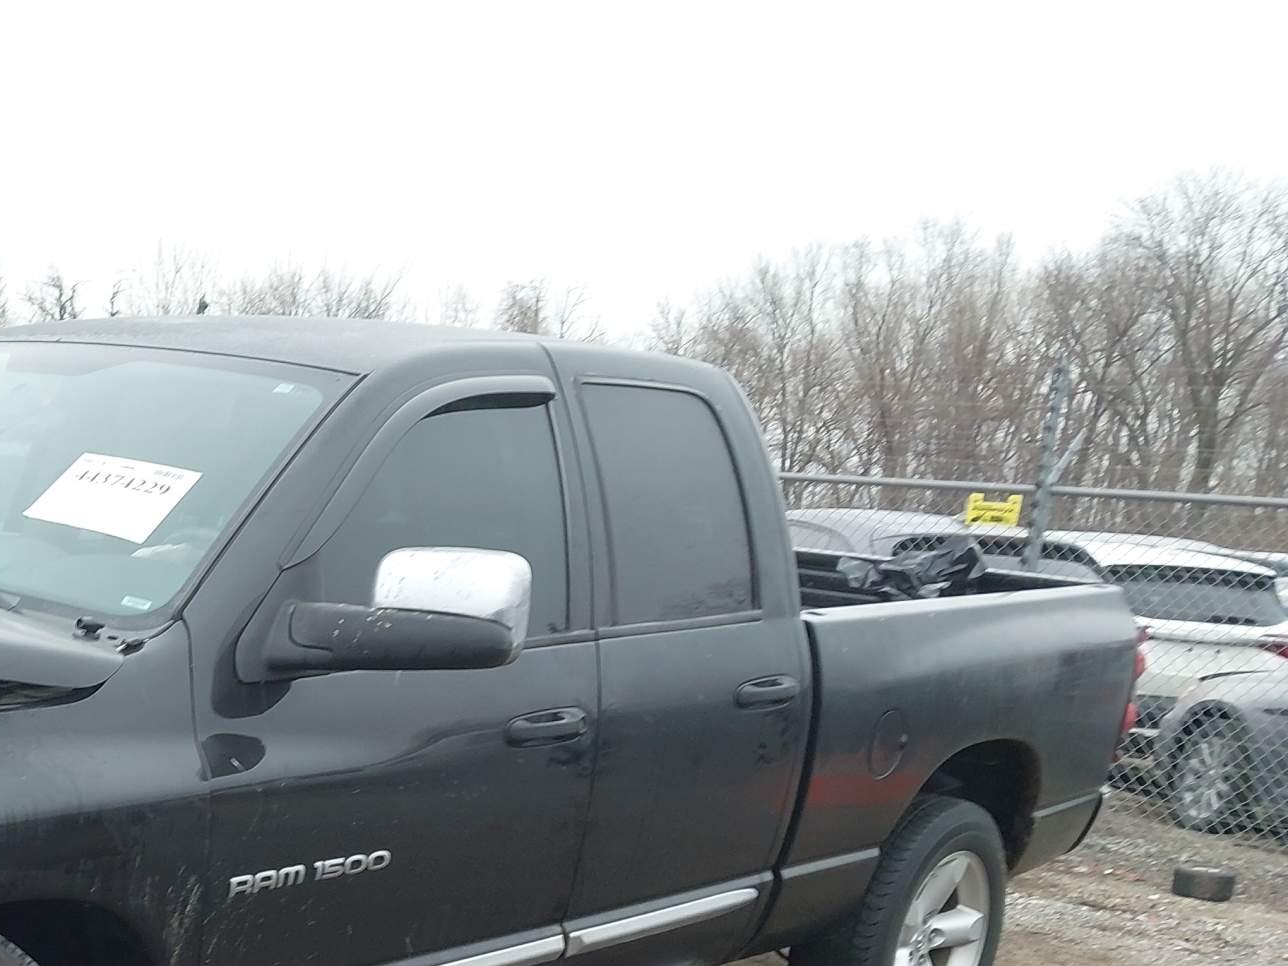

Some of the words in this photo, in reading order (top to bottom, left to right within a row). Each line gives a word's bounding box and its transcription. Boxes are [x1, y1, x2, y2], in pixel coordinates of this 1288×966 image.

[75, 469, 171, 495] 44374229
[228, 864, 306, 898] RAM
[313, 850, 392, 880] 1500
